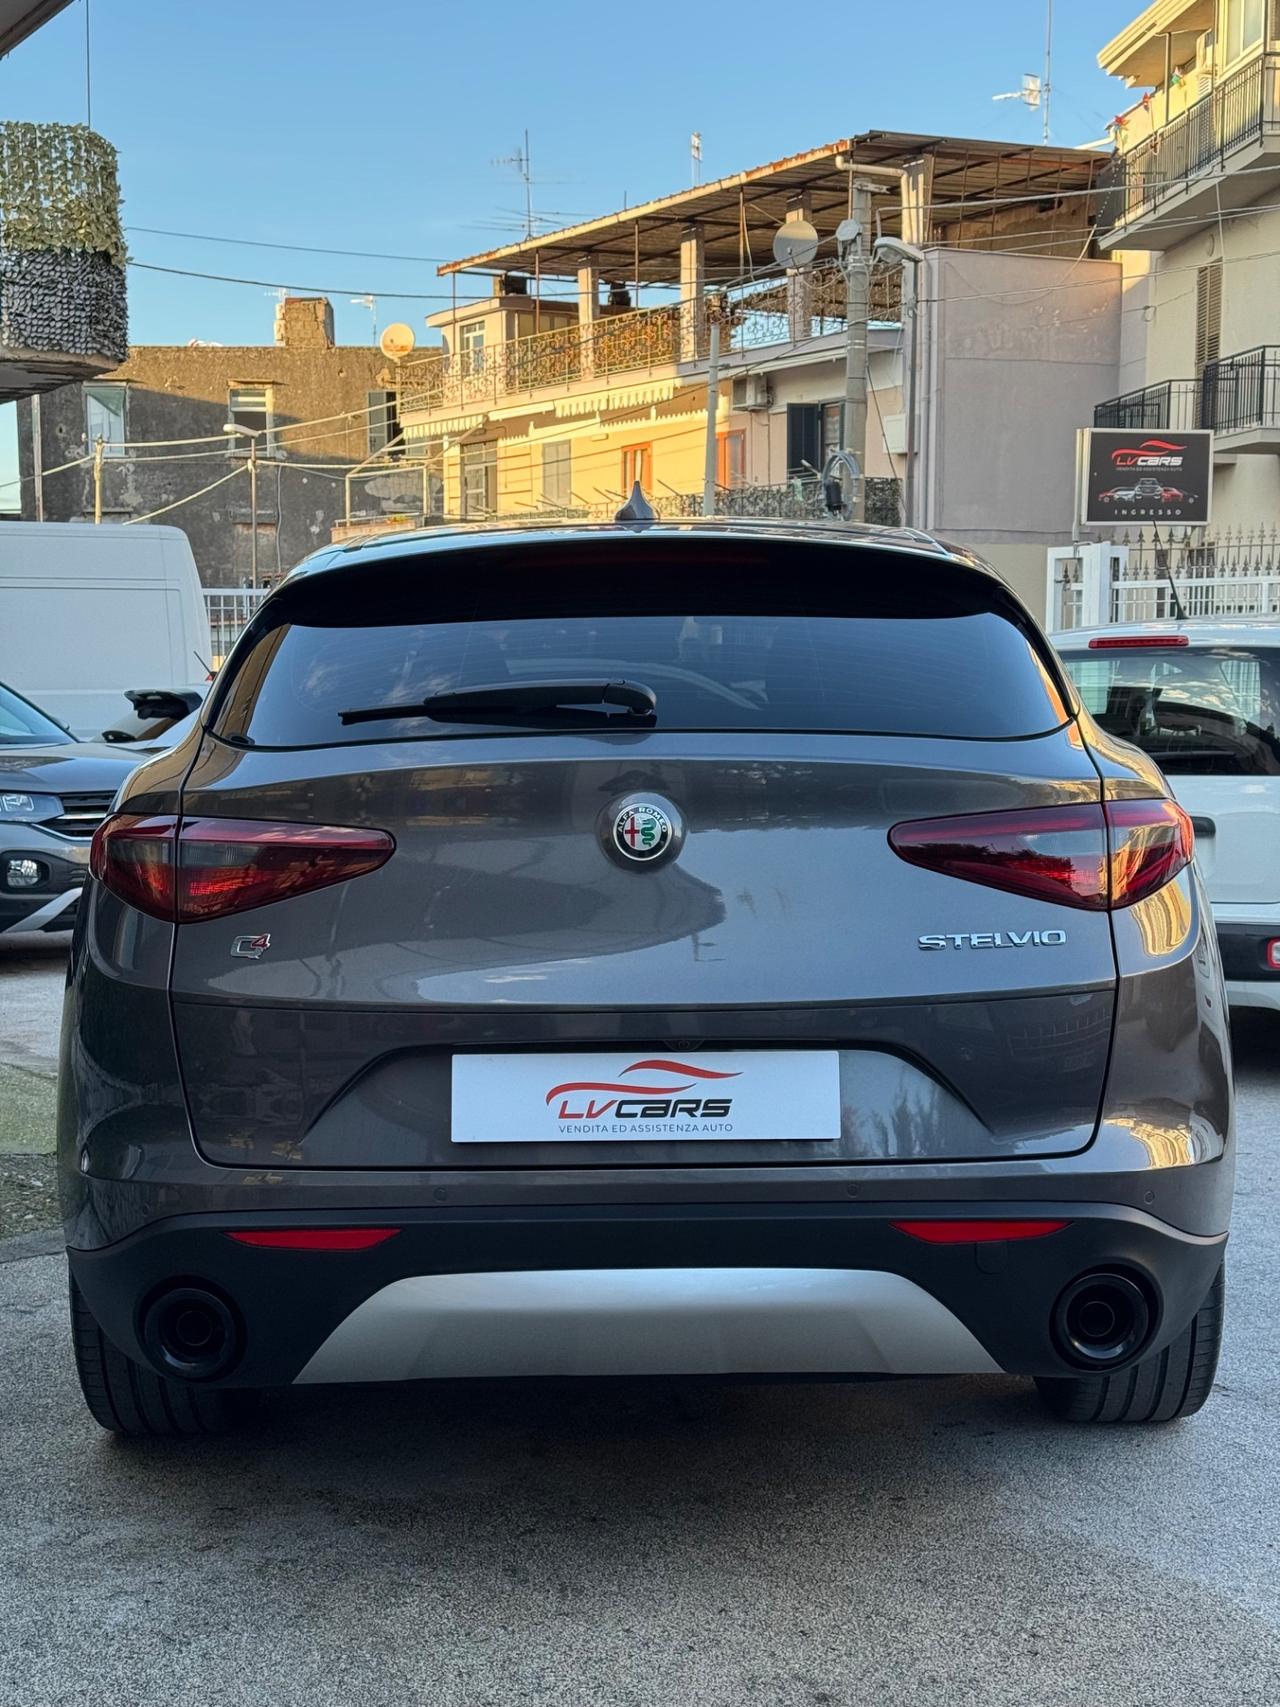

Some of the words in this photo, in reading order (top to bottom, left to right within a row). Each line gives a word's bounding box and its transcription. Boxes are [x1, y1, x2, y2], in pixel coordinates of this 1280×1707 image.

[617, 811, 635, 832] ALFA
[638, 807, 668, 833] ROMEO
[230, 933, 271, 959] Q4
[918, 930, 1067, 950] STELVIO
[559, 1124, 608, 1133] VENDITA
[611, 1124, 627, 1133] ED
[630, 1123, 699, 1133] ASSISTENZA
[702, 1123, 733, 1132] AUTO
